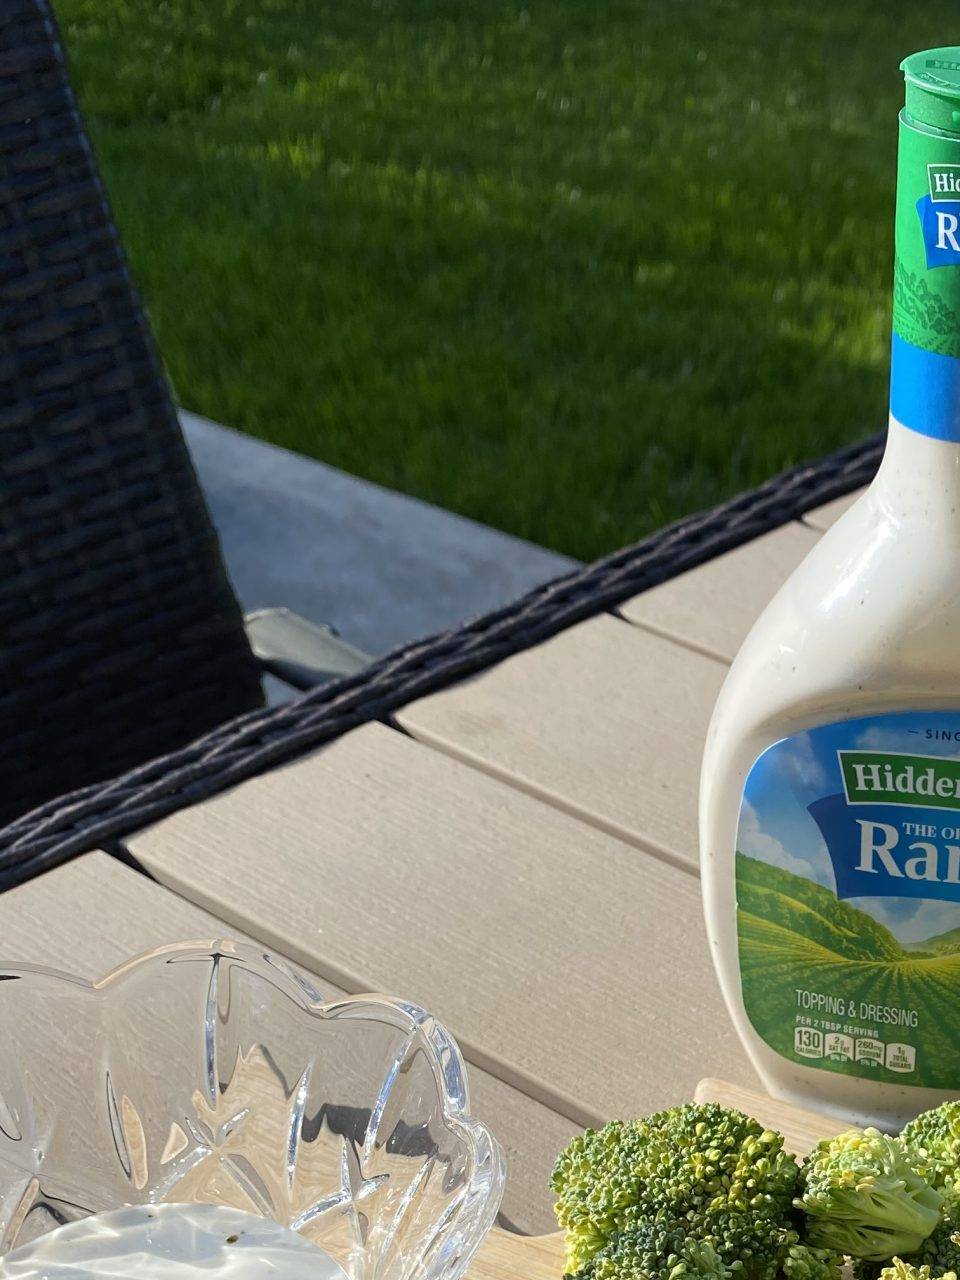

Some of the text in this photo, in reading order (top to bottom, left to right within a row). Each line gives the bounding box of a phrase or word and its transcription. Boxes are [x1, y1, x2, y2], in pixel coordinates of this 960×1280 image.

[902, 822, 936, 838] THE
[795, 989, 918, 1027] TOPPING & DRESSING
[796, 1015, 879, 1038] PER 2 TBSP SERVING
[796, 1029, 820, 1049] 130
